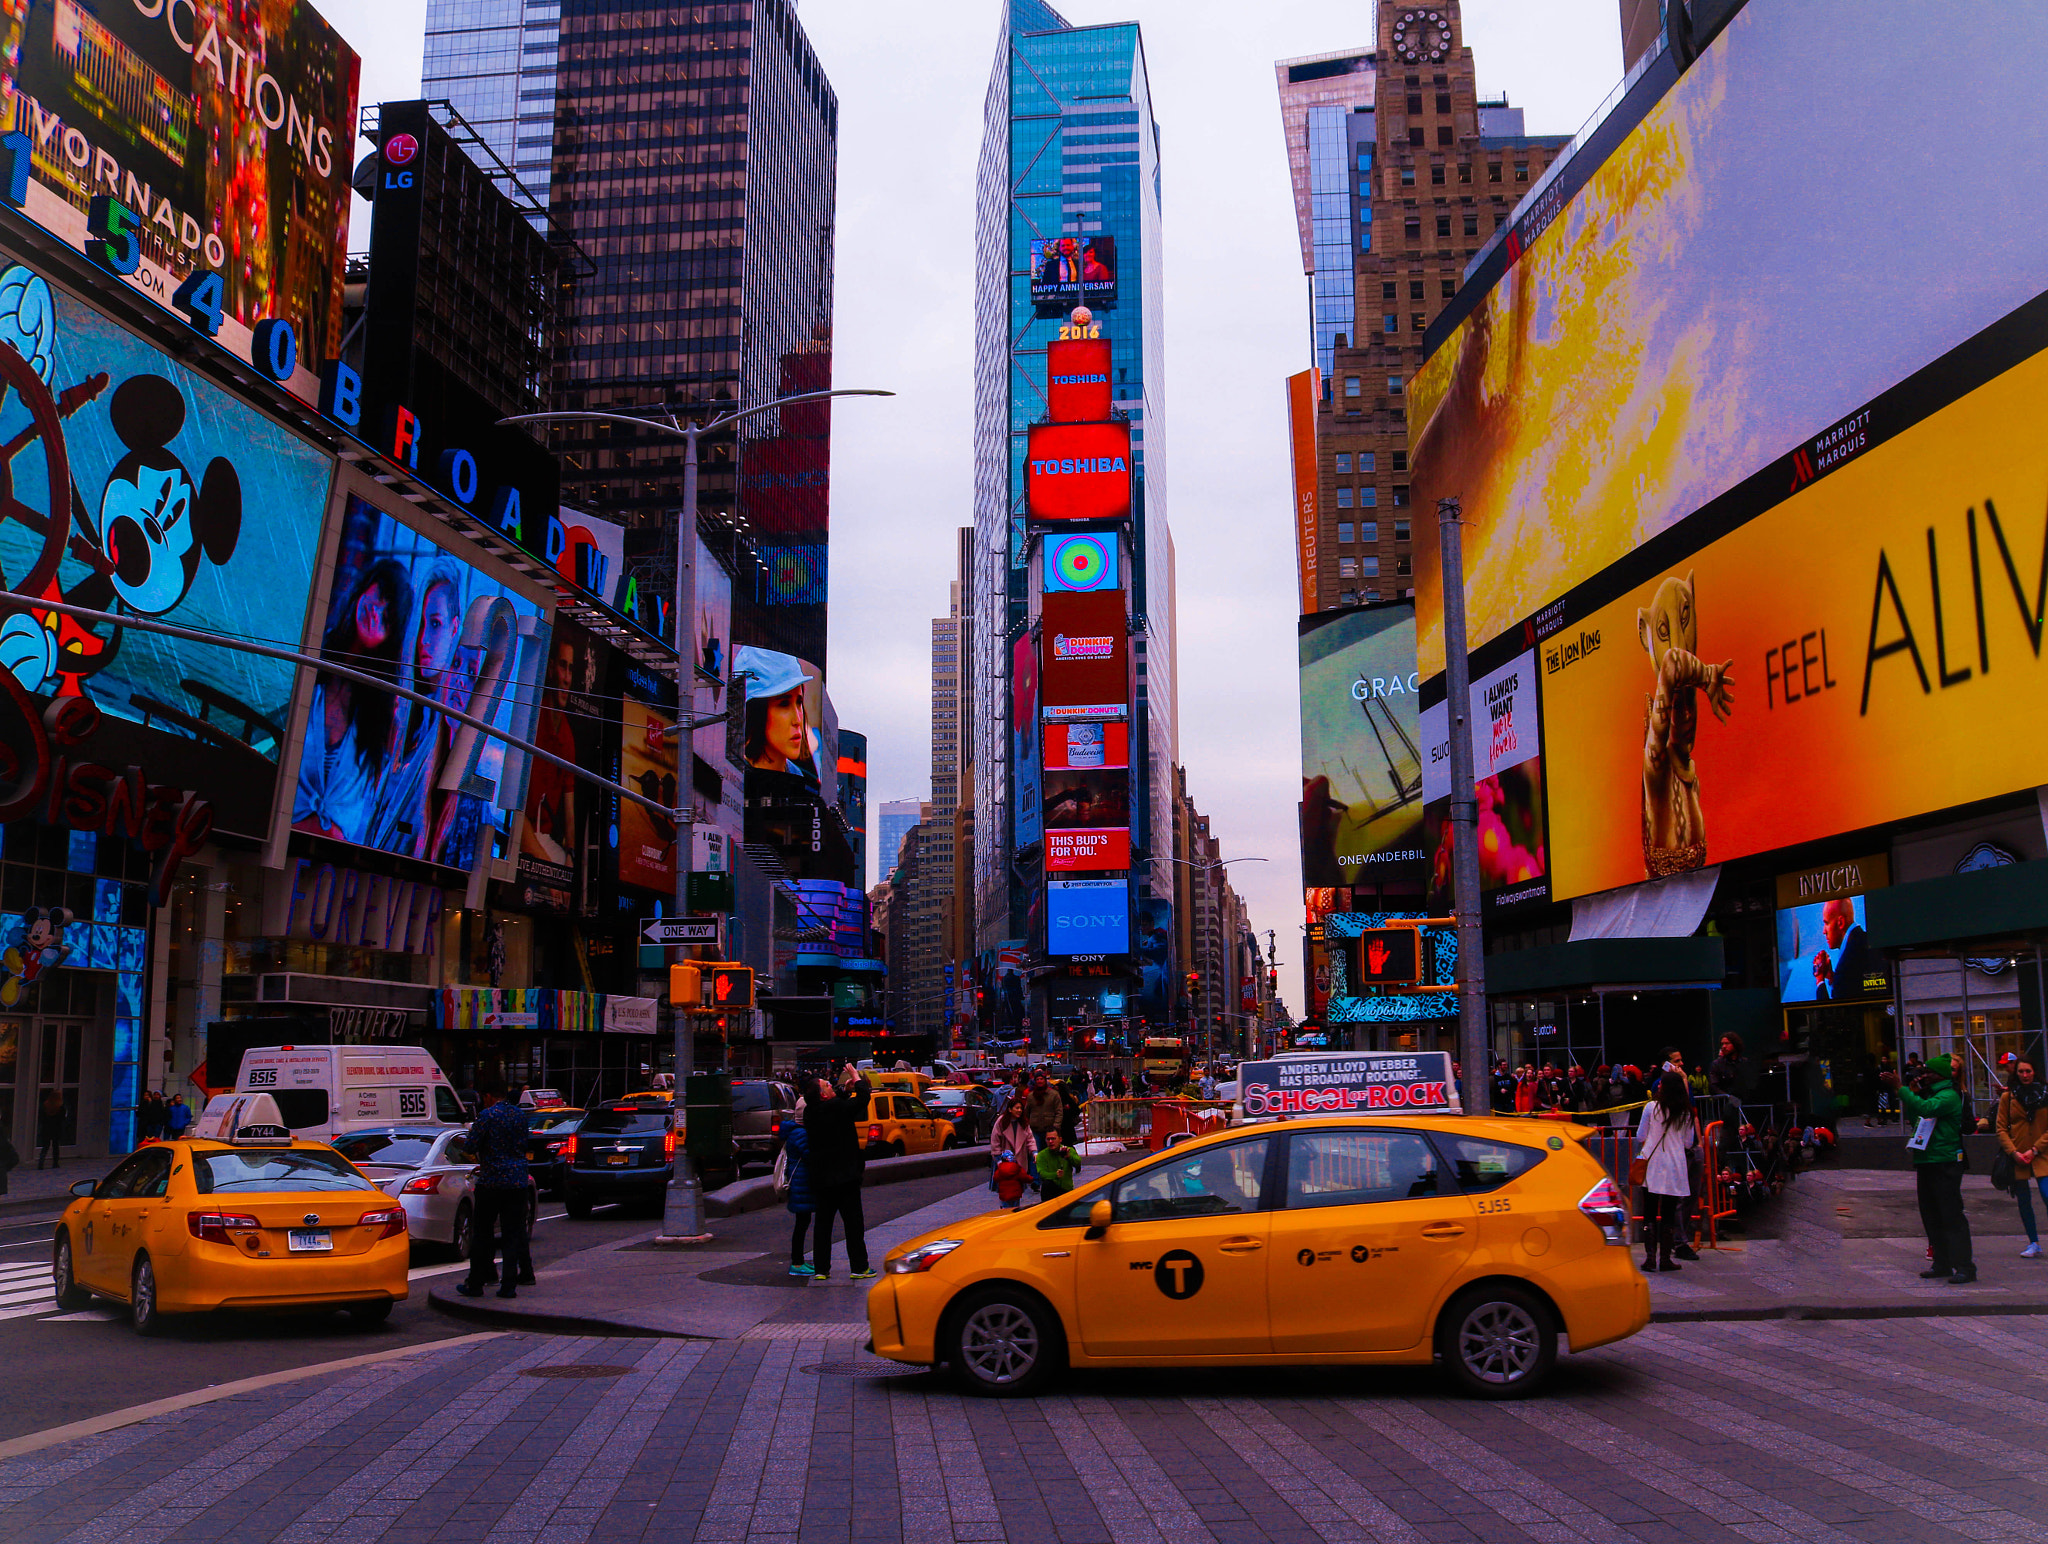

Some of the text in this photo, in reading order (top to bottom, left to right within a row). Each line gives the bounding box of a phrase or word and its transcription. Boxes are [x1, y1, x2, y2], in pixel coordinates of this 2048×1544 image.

[30, 96, 225, 268] VORNADO
[385, 171, 413, 189] LG
[1523, 174, 1565, 230] MARRIOTT
[1525, 199, 1562, 248] MARQUIS
[1032, 284, 1058, 293] HAPPY
[1059, 325, 1100, 340] 2016
[1052, 374, 1107, 385] TOSHIBA
[1816, 409, 1871, 454] MARRIOTT
[1817, 432, 1867, 471] MARQUIS
[1032, 457, 1126, 475] TOSHIBA
[333, 360, 669, 638] BROADWAY
[1303, 491, 1317, 571] REUTERS
[1536, 600, 1566, 625] MARRIOTT
[1070, 645, 1112, 655] DONUTS
[1560, 644, 1579, 670] LION
[1580, 629, 1601, 660] KING
[1765, 627, 1837, 711] FEEL
[1484, 673, 1518, 706] I ALWAYS
[1490, 695, 1513, 721] WANT
[811, 806, 822, 852] 1500
[1050, 835, 1108, 846] THIS BUD'S
[1051, 846, 1097, 857] FOR YOU.
[1799, 864, 1863, 897] INVICTA
[286, 858, 443, 956] FOREVER
[664, 926, 710, 936] ONE WAY
[1055, 914, 1125, 928] SONY
[1071, 954, 1107, 962] SONY
[1068, 965, 1112, 976] THE WALL
[330, 1007, 390, 1038] FOREVER
[1330, 1061, 1367, 1074] LLOYD
[1369, 1059, 1417, 1070] WEBBER
[249, 1071, 277, 1084] BSIS
[1279, 1075, 1303, 1087] HAS
[1304, 1073, 1364, 1086] BROADWAY
[400, 1093, 426, 1113] BSIS
[1366, 1081, 1447, 1109] ROCK
[250, 1127, 275, 1137] 7Y44
[1130, 1262, 1153, 1270] NYC
